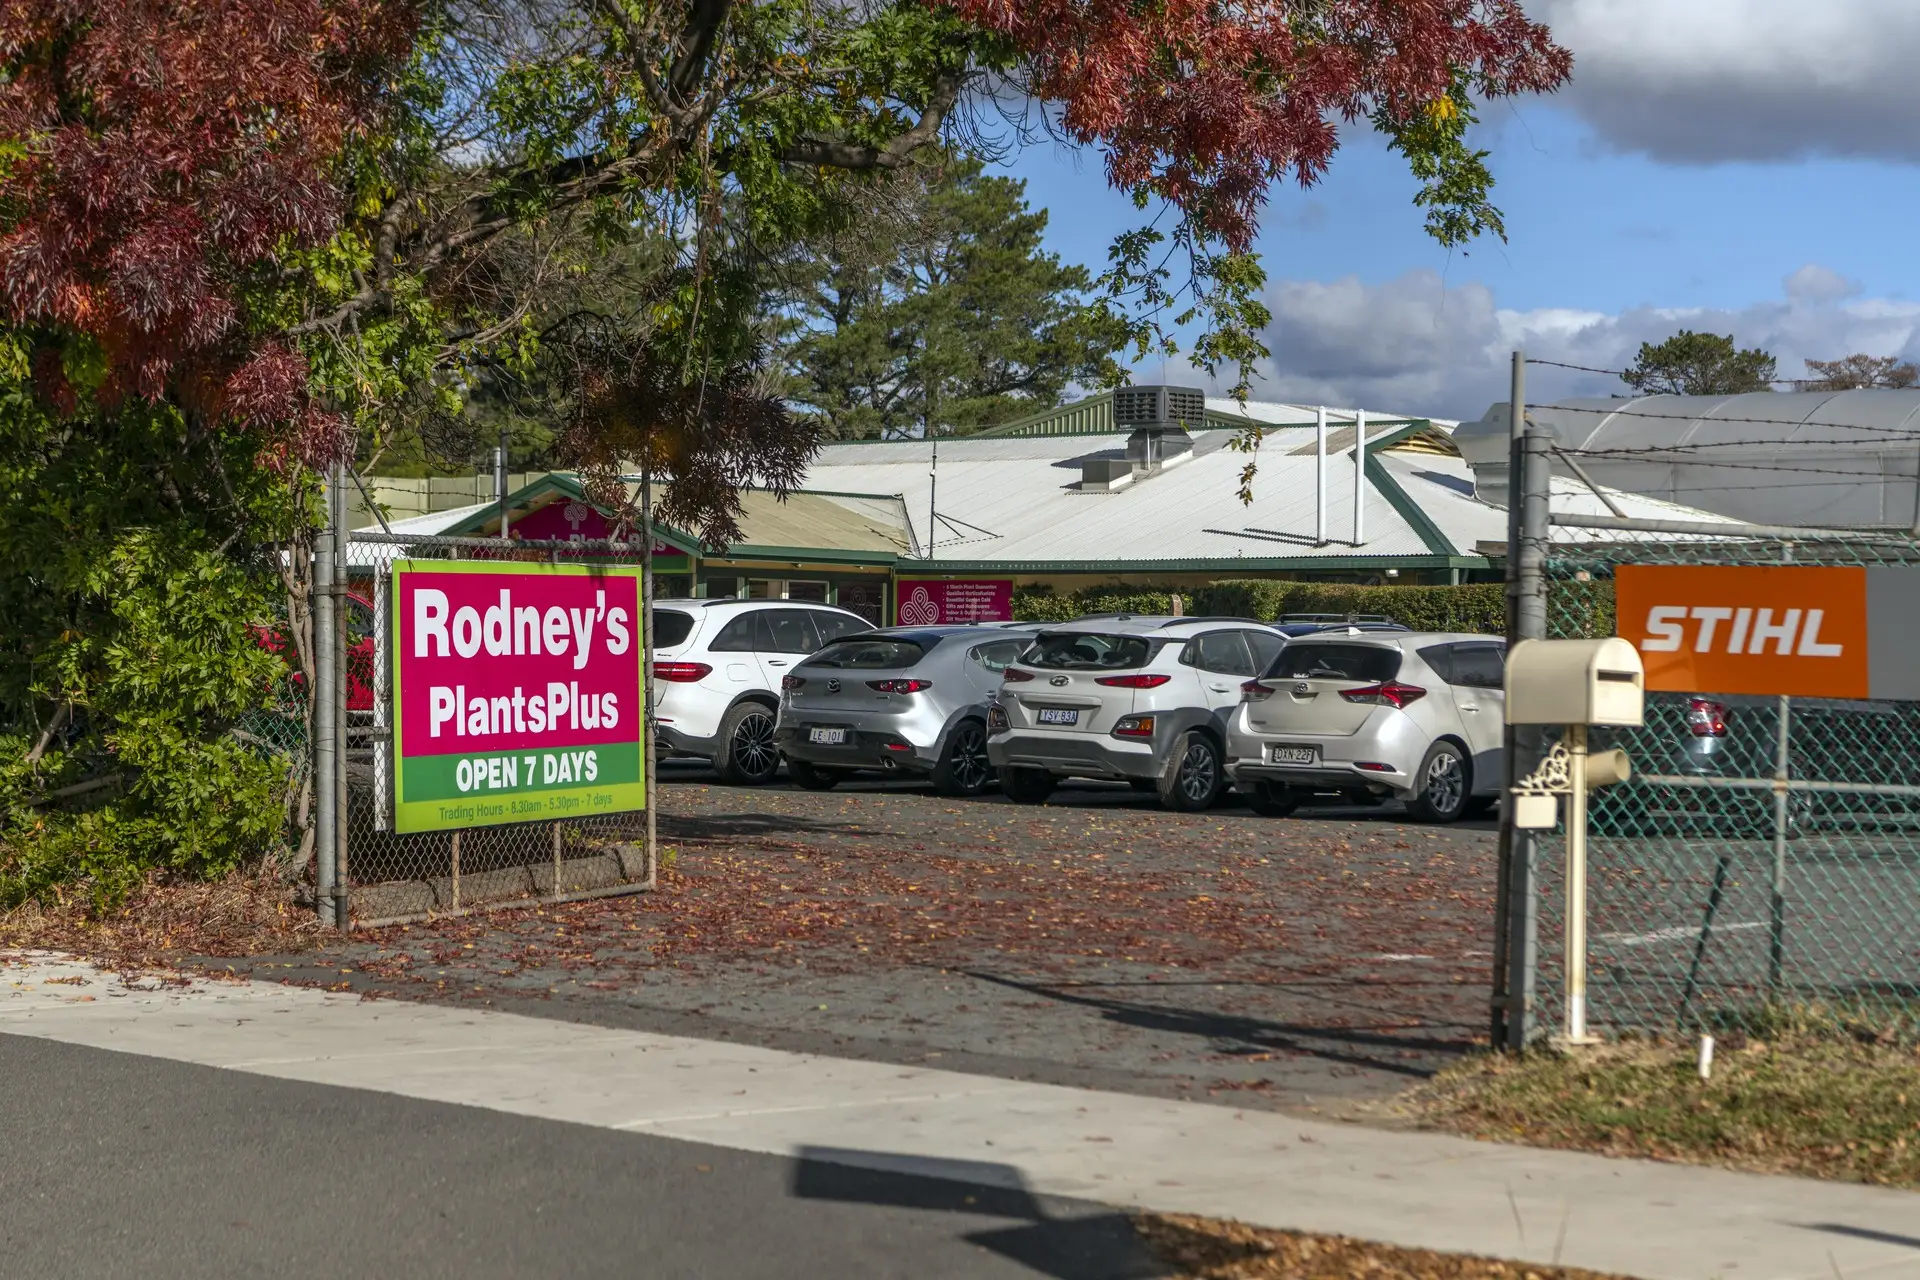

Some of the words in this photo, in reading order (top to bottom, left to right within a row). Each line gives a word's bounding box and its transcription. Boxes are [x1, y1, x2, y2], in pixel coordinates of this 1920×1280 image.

[414, 588, 630, 669] Rodney's
[1640, 606, 1844, 656] STIHL
[430, 681, 619, 738] PlantsPlus
[456, 757, 518, 792] OPEN
[524, 756, 536, 786] 7
[544, 750, 598, 784] DAYS
[439, 804, 474, 822] Trading
[476, 802, 504, 817] Hours
[511, 798, 542, 814] 8.30am
[549, 796, 579, 812] 5.30pm
[586, 794, 592, 804] 7
[593, 793, 612, 806] days
